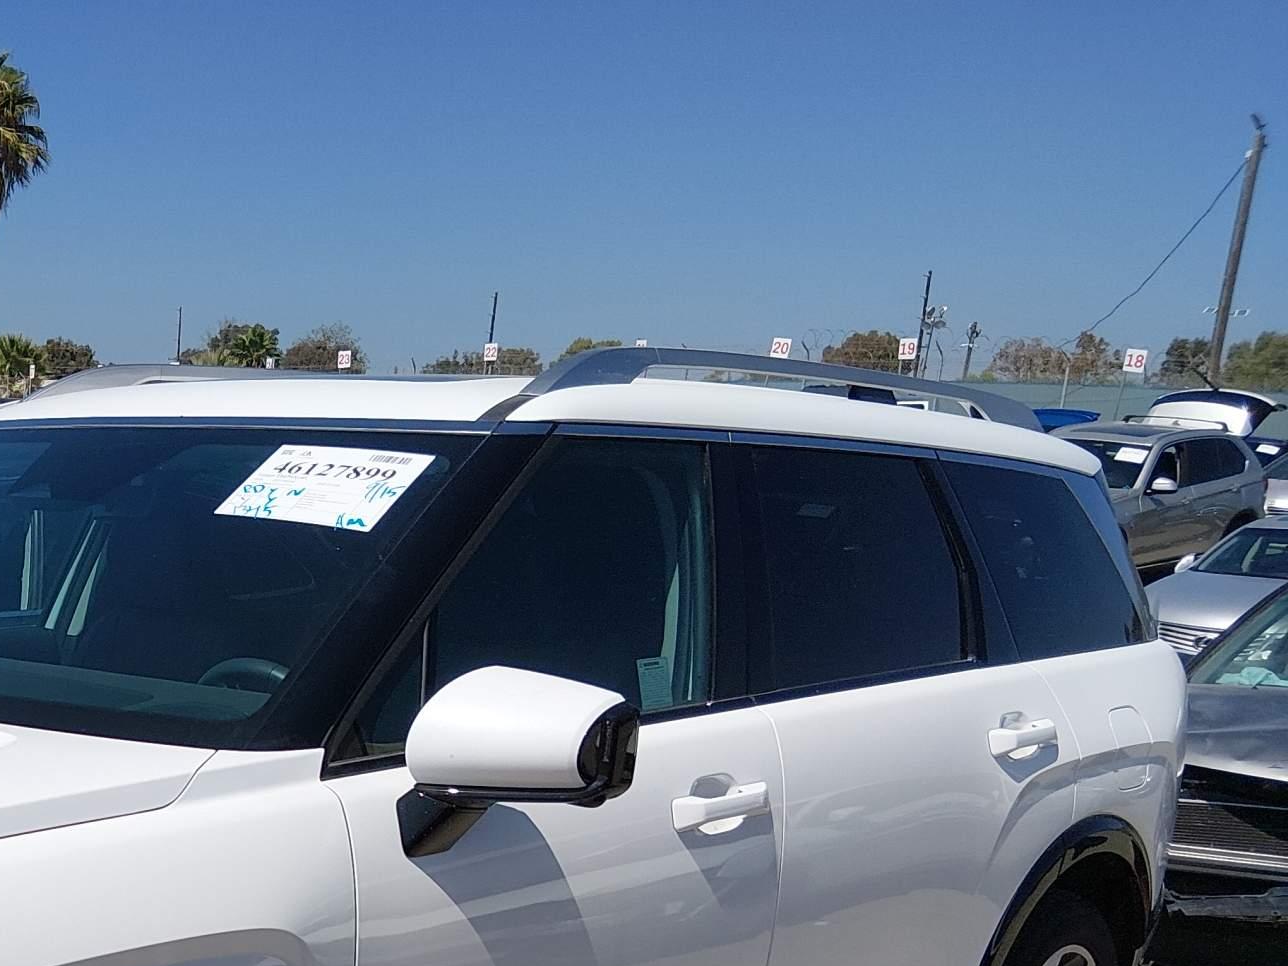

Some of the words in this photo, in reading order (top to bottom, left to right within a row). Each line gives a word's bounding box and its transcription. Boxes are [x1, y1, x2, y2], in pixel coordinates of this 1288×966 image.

[485, 346, 496, 358] 22
[772, 341, 789, 354] 20
[899, 342, 915, 355] 19
[338, 353, 350, 365] 23
[1125, 353, 1145, 368] 18
[273, 460, 397, 482] 46127899
